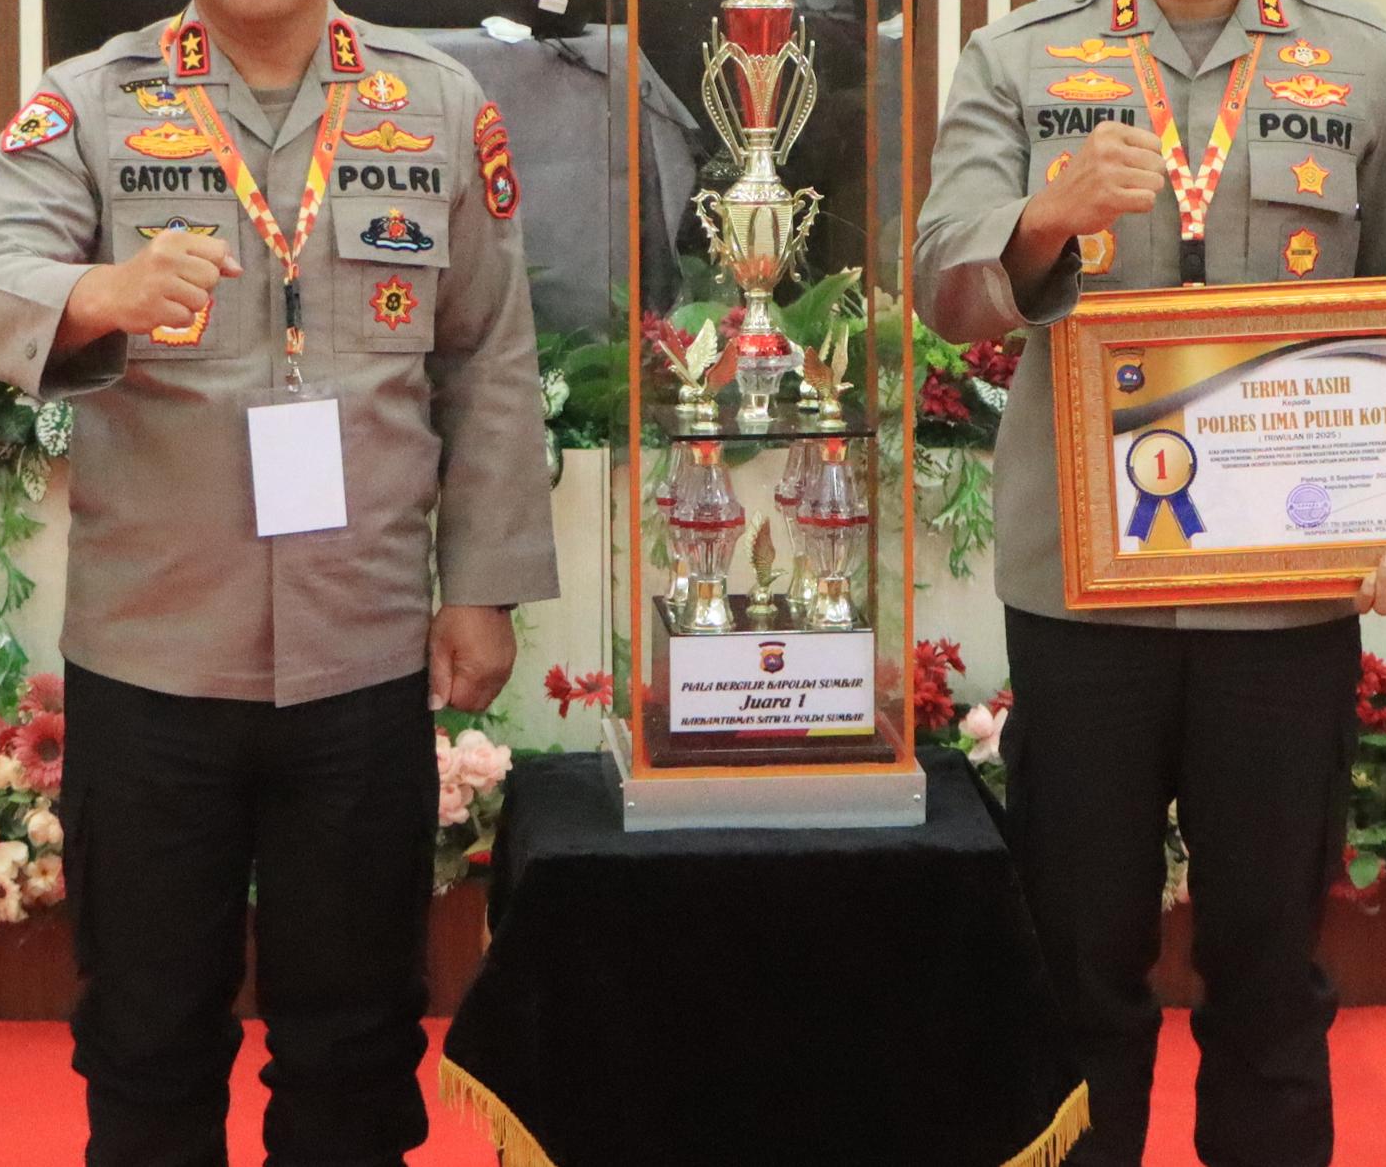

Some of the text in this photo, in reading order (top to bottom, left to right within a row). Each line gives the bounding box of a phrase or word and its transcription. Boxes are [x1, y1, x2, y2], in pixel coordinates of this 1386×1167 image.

[1258, 113, 1353, 149] POLRI
[119, 165, 228, 193] GATOT TS
[338, 165, 441, 194] POLRI
[1240, 376, 1351, 399] TERIMA KASIH
[1196, 413, 1257, 435] POLRES
[1261, 411, 1298, 431] LIMA
[1304, 409, 1354, 429] PULUH
[1153, 449, 1168, 480] 1
[681, 681, 714, 692] PIALA
[767, 679, 816, 691] KAPOLDA
[818, 678, 864, 688] SUMBAR
[739, 694, 791, 711] Juara
[680, 714, 756, 726] HARKAMTIBMAS
[793, 713, 825, 722] POLDA
[826, 712, 864, 722] SUMBAR
